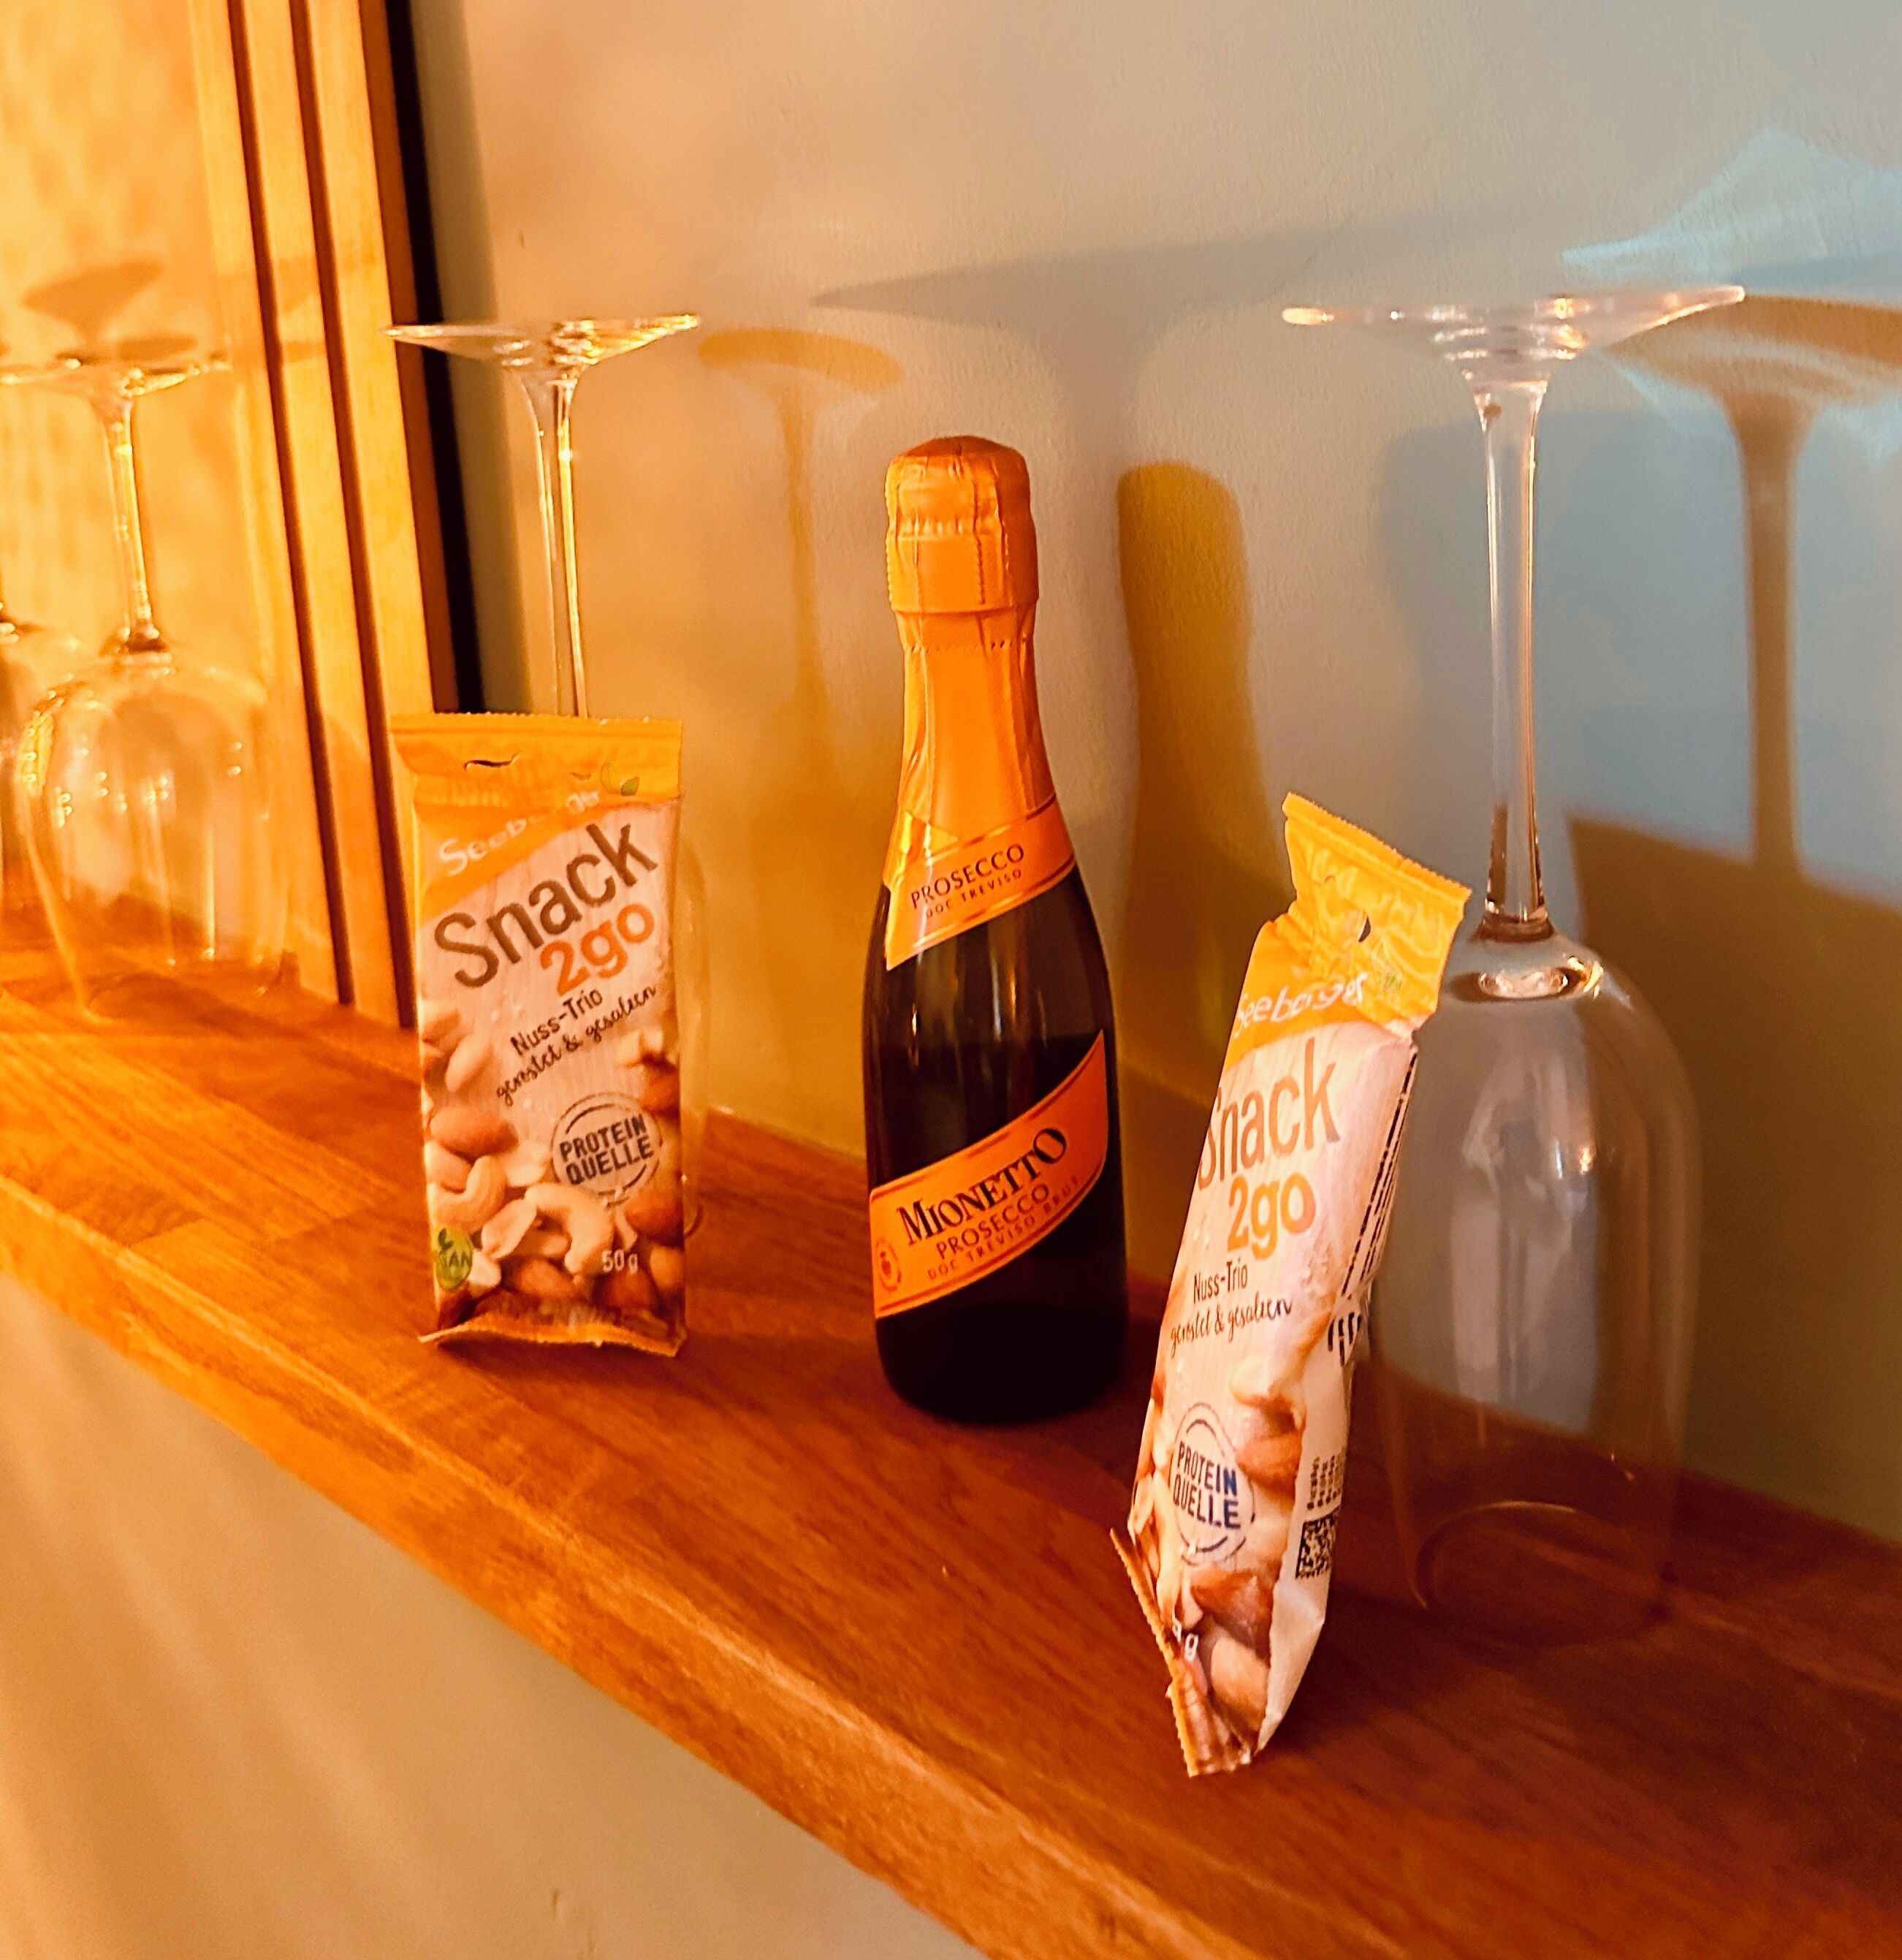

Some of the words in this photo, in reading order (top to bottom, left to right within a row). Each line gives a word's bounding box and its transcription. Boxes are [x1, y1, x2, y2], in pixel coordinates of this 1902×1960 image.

[438, 790, 601, 876] Seeber
[434, 823, 658, 988] Snack
[910, 843, 1024, 909] PROSECCO
[960, 868, 1023, 903] TREVISO
[539, 903, 655, 996] 2go
[510, 989, 604, 1057] Nuss-Trio
[562, 1033, 584, 1052] &
[559, 1114, 647, 1163] PROTEIN
[1198, 1038, 1341, 1191] Snack
[566, 1134, 655, 1185] QUELLE
[896, 1127, 1068, 1247] MIONETTO
[927, 1261, 959, 1280] DOC
[968, 1215, 1036, 1263] TREVISO
[935, 1183, 1050, 1260] PROSECCO
[1226, 1172, 1317, 1261] 2go
[1193, 1257, 1248, 1304] Nuss-Trio
[1214, 1304, 1225, 1336] &
[1177, 1440, 1238, 1497] PROTEIN
[1173, 1473, 1241, 1530] QUELLE
